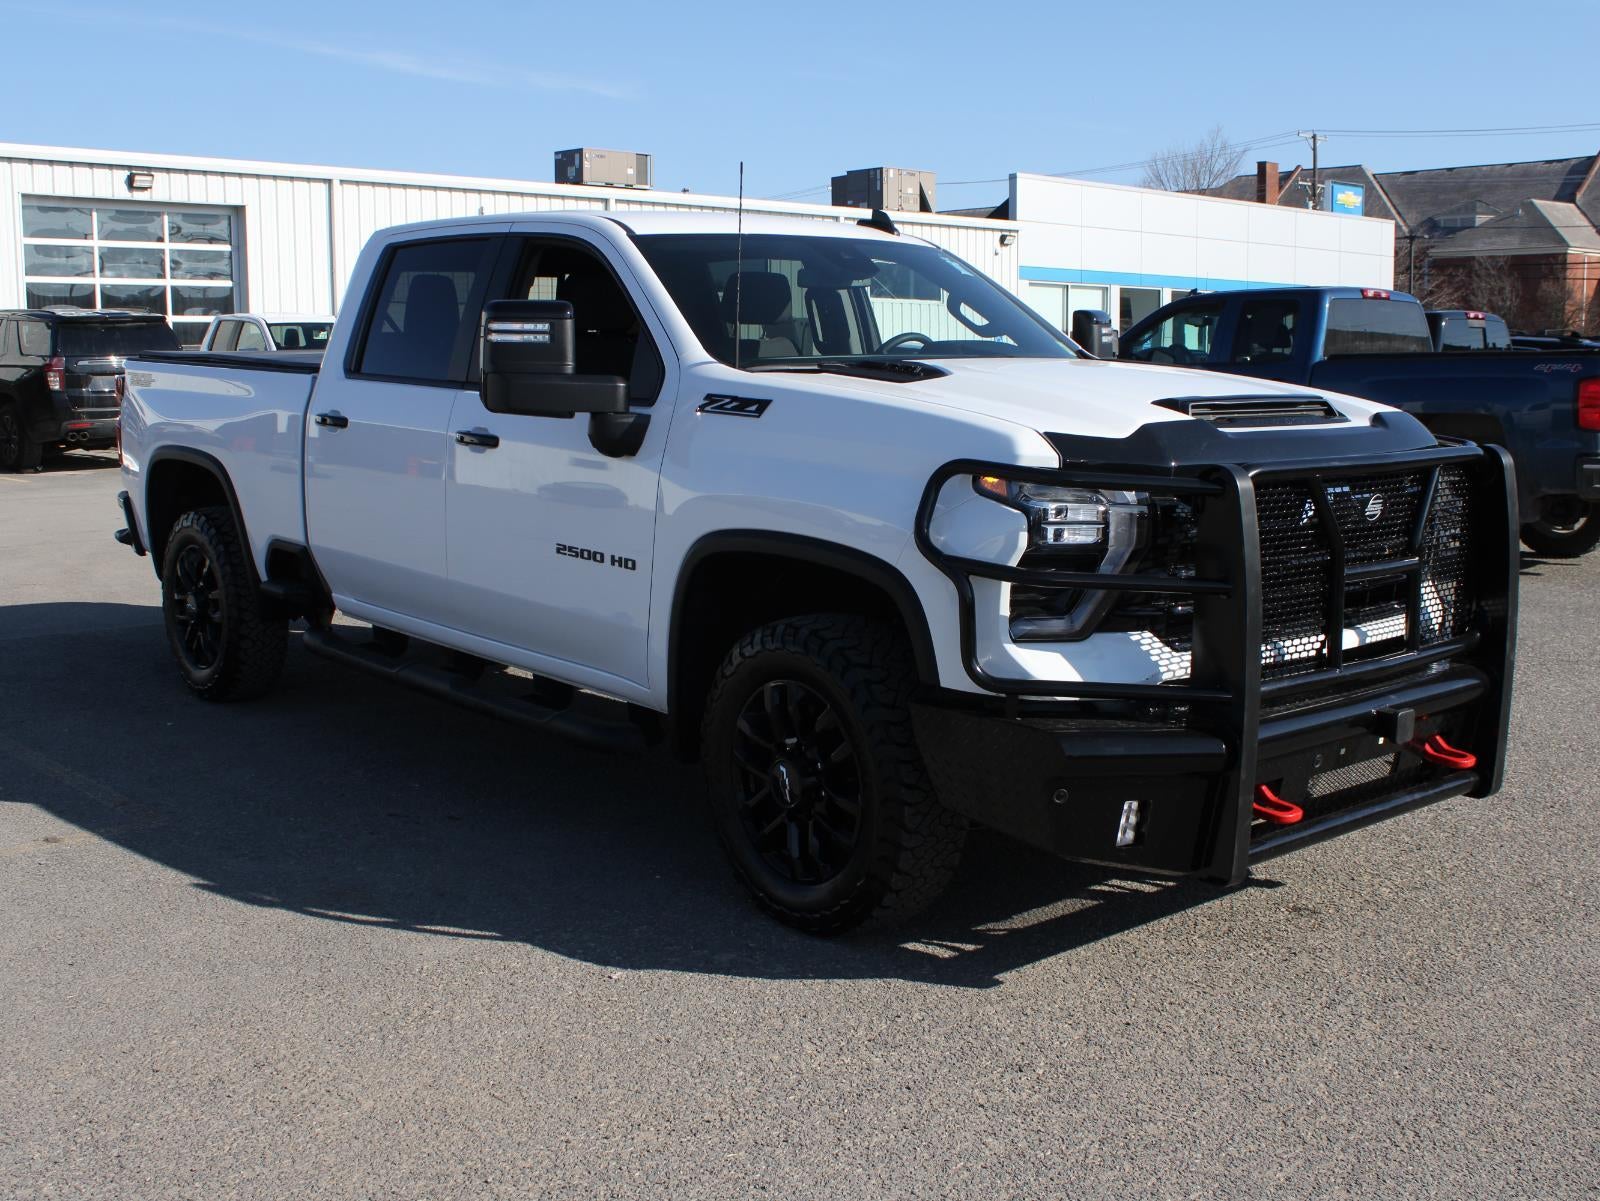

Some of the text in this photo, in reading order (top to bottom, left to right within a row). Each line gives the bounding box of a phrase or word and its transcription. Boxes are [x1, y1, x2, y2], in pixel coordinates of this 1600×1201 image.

[696, 393, 773, 418] Z71
[555, 543, 636, 571] 2500 HD
